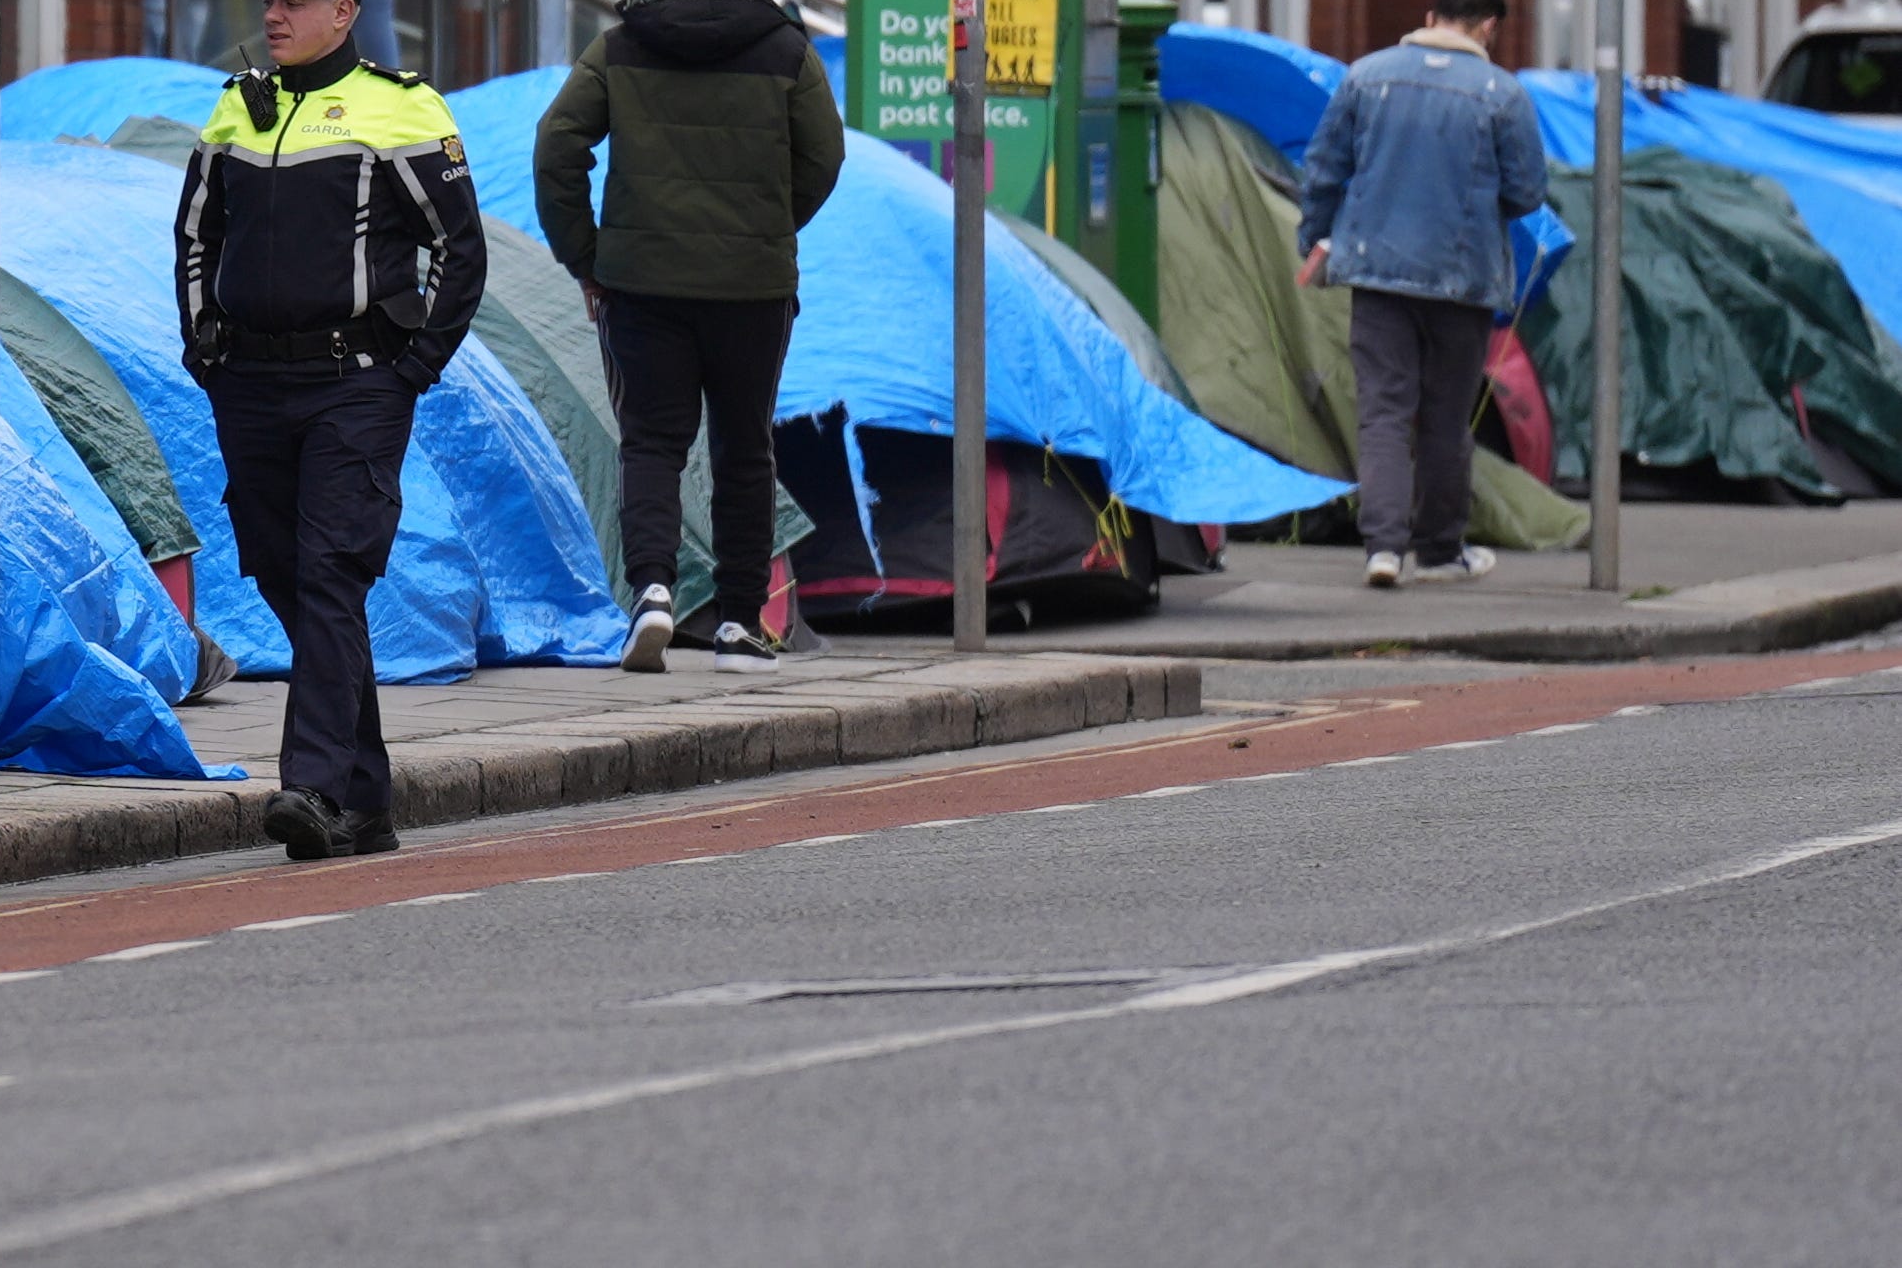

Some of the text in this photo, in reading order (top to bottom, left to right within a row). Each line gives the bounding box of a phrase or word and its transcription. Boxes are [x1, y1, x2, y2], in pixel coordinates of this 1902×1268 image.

[880, 10, 950, 38] Do yo
[880, 71, 904, 95] in
[880, 102, 940, 130] post
[301, 124, 352, 138] GARDA
